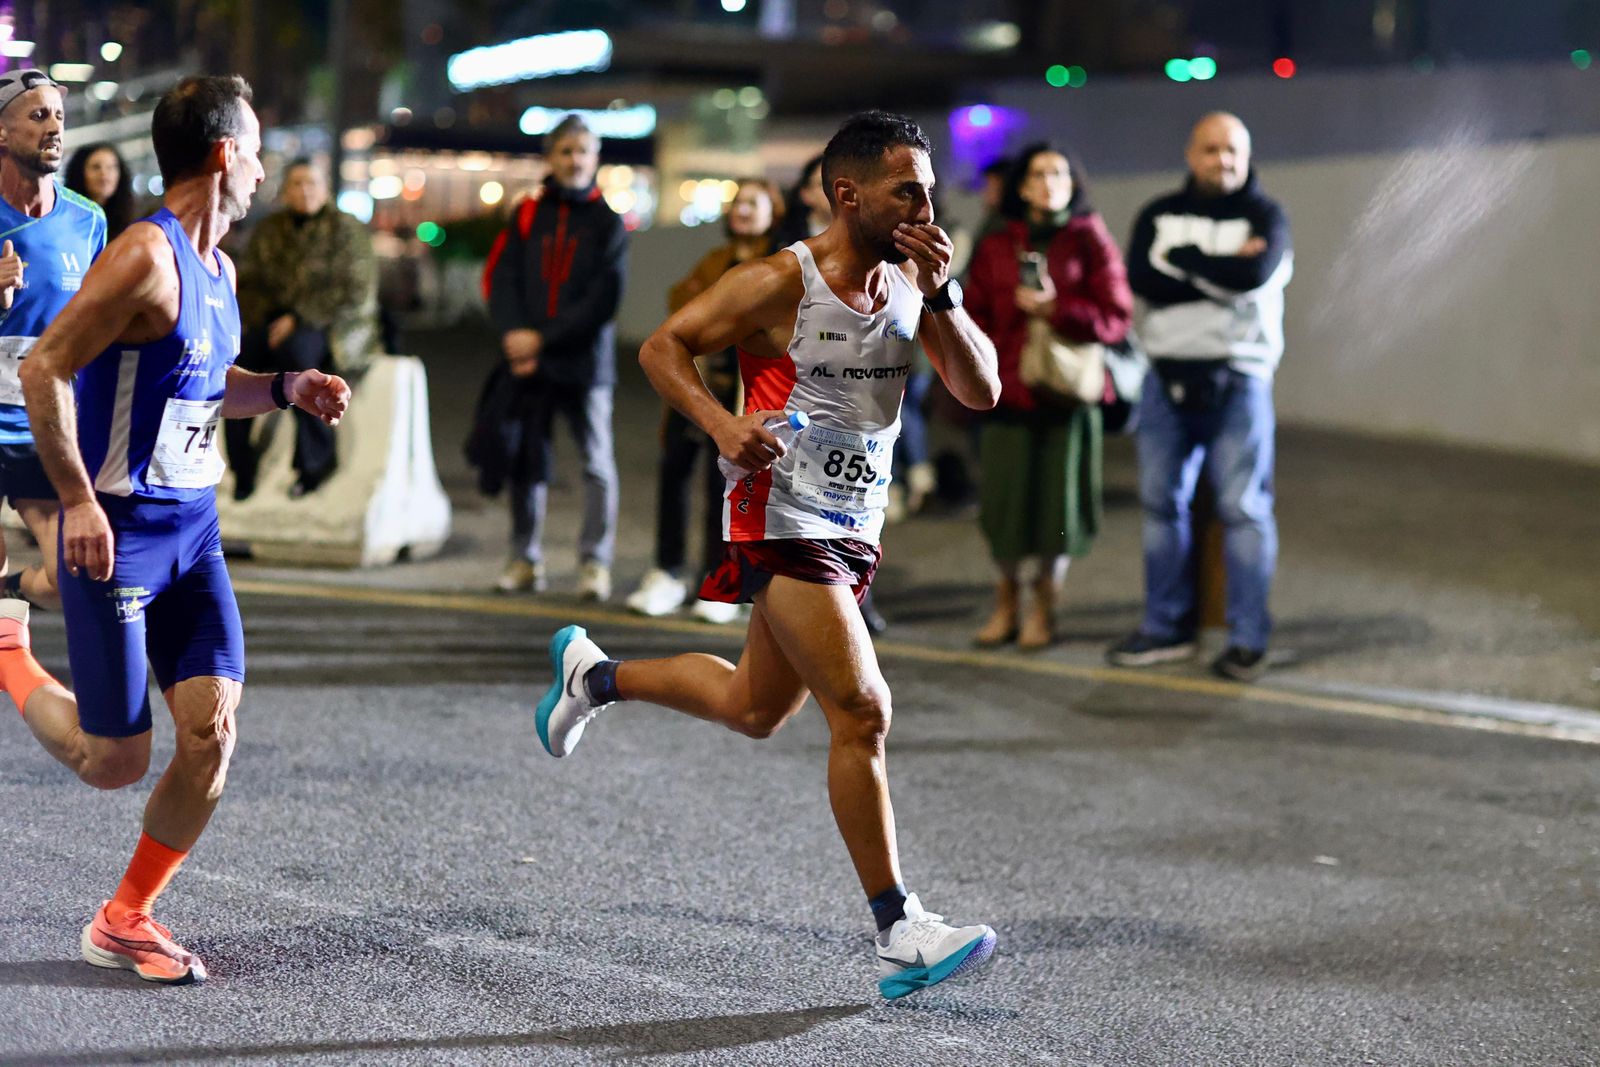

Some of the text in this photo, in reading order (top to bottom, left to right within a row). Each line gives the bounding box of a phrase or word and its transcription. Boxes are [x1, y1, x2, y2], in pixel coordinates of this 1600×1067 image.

[810, 366, 835, 377] AL
[184, 425, 216, 454] 74
[823, 449, 877, 484] 859
